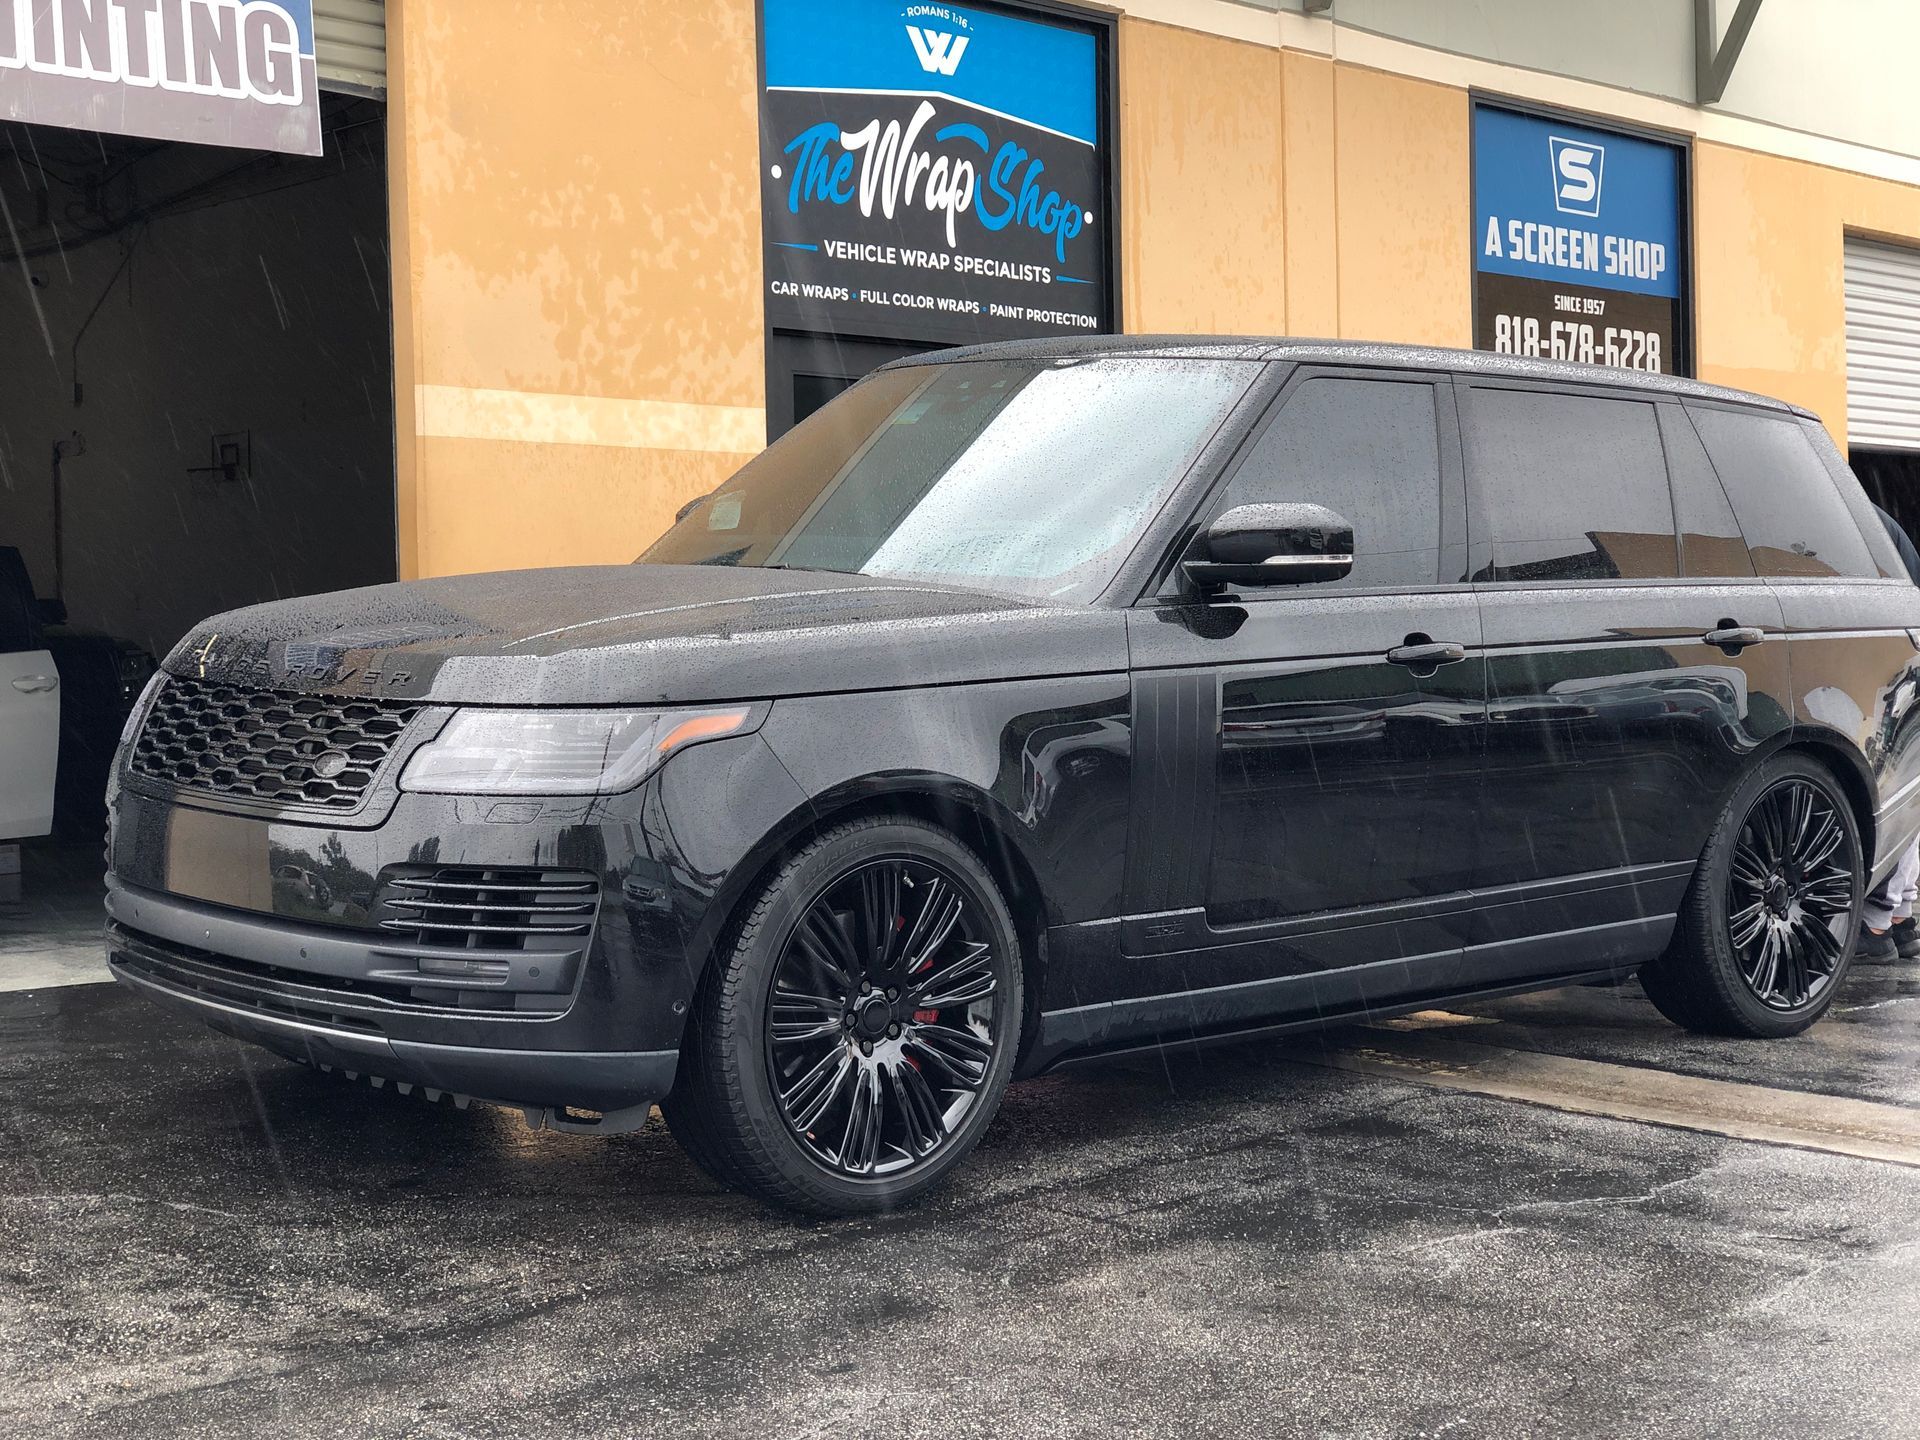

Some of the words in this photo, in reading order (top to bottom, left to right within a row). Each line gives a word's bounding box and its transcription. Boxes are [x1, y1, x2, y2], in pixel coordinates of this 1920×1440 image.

[907, 6, 950, 20] ROMANS
[952, 12, 968, 29] 1:16
[784, 122, 855, 214] The
[840, 100, 974, 247] Wrap
[935, 123, 1082, 263] Shop
[824, 240, 896, 265] VEHICLE
[900, 248, 950, 271] WRAP
[953, 255, 1052, 284] SPECIALISTS
[1484, 216, 1503, 258] A
[1508, 219, 1599, 272] SCREEN
[1604, 235, 1666, 281] SHOP
[771, 280, 799, 296] CAR
[801, 284, 849, 301] WRAPS
[860, 289, 890, 305] FULL
[892, 293, 935, 310] COLOR
[936, 297, 980, 315] WRAPS
[989, 303, 1023, 320] PAINT
[1026, 307, 1097, 329] PROTECTION
[1554, 295, 1581, 312] SINCE
[1582, 297, 1606, 316] 1957
[285, 664, 413, 687] ROVER
